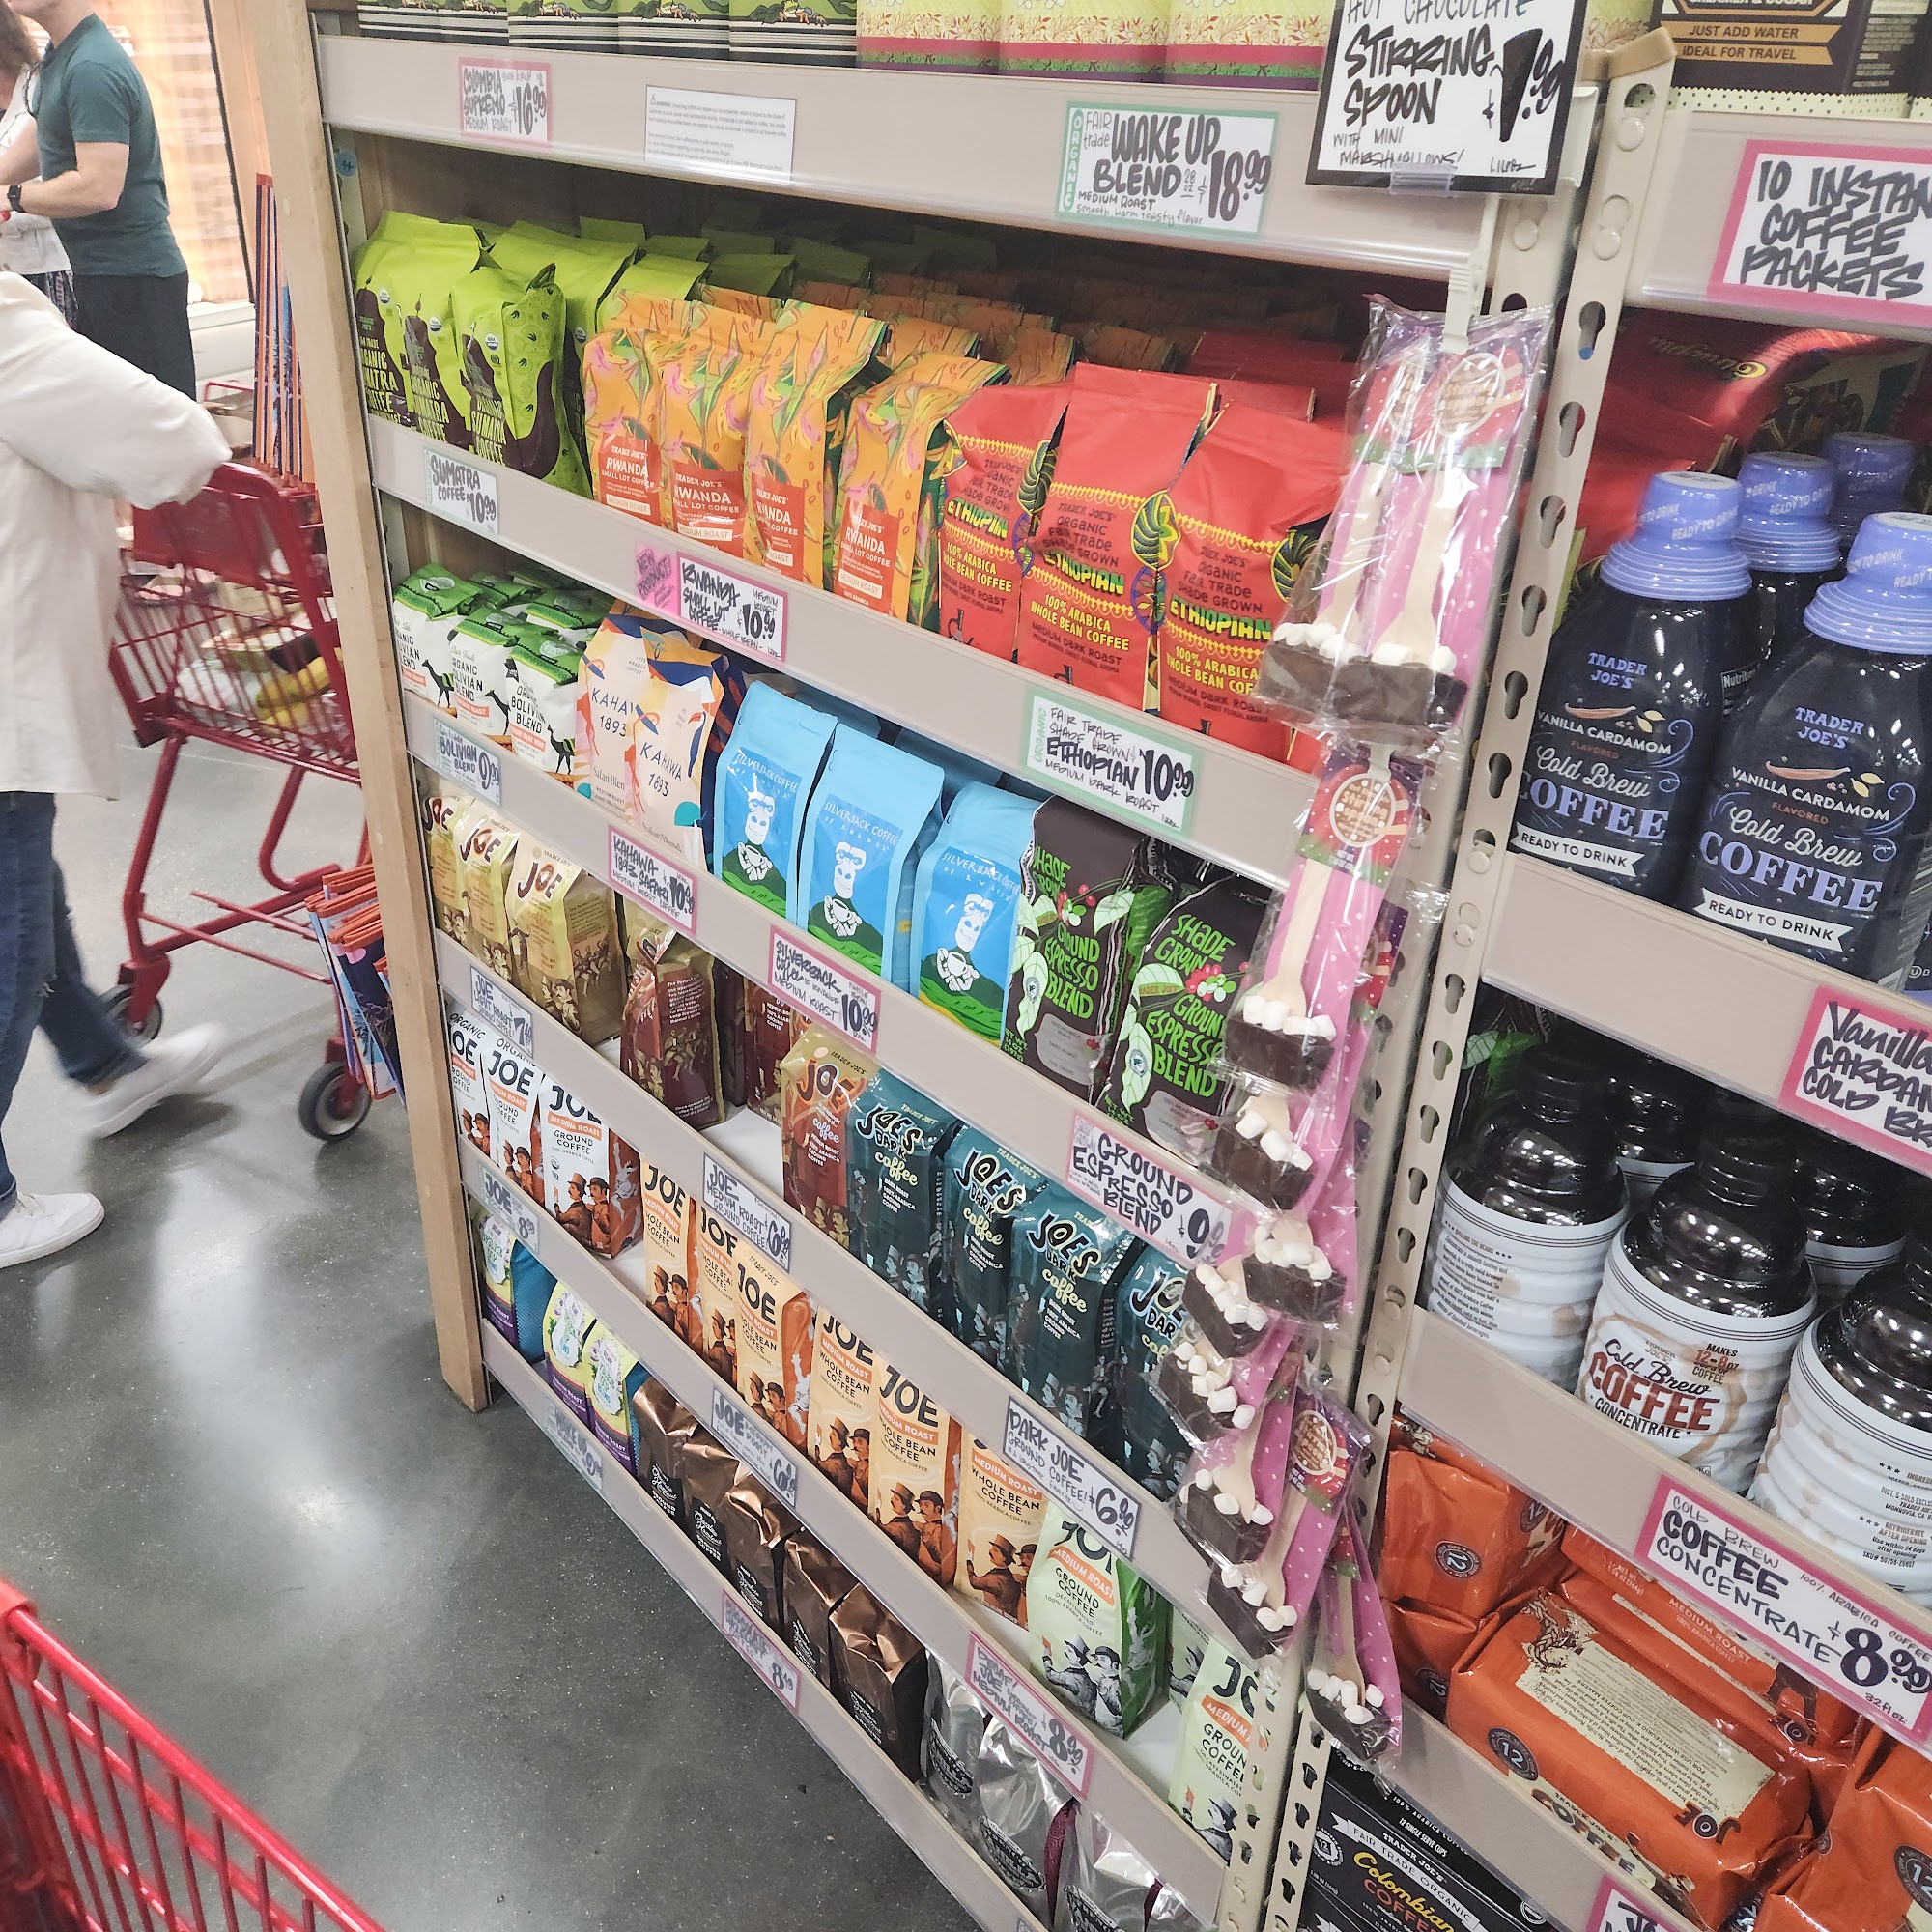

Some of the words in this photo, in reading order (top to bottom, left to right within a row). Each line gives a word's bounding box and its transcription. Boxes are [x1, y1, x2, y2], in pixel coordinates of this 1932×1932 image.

[1690, 26, 1719, 37] JUST
[1723, 26, 1750, 38] ADD
[1754, 27, 1799, 39] WATER
[1344, 23, 1495, 78] STIRRING
[1682, 45, 1717, 57] IDEAL
[1720, 47, 1745, 58] FOR
[1748, 48, 1797, 60] TRAVEL
[464, 66, 503, 96] COLOMBIA
[464, 93, 506, 116] SUPREMO
[1344, 78, 1442, 127] SPOON
[1086, 112, 1111, 130] FAIR
[1084, 132, 1110, 149] trade
[1111, 113, 1182, 163] WAKE
[1185, 114, 1221, 165] UP
[1333, 128, 1361, 148] WITH
[1374, 126, 1404, 145] MINI
[1093, 159, 1182, 198] BLEND
[1757, 160, 1793, 202] 10
[1078, 191, 1118, 204] MEDIUM
[1121, 196, 1156, 211] ROAST
[1759, 203, 1915, 257] COFFEE
[1740, 245, 1925, 300] PACKETS
[431, 454, 481, 490] SUMATRA
[602, 469, 618, 480] SMALL
[619, 473, 630, 482] LOT
[606, 457, 649, 477] RWANDA
[438, 485, 466, 502] COFFEE
[692, 502, 706, 511] LOT
[708, 504, 740, 513] COFFEE
[704, 529, 728, 539] ROAST
[845, 527, 886, 554] RWANDA
[1073, 533, 1112, 552] TRADE
[855, 549, 865, 558] LOT
[866, 554, 891, 567] COFFEE
[963, 552, 996, 576] ARABICA
[957, 561, 976, 583] BEAN
[977, 571, 1012, 593] COFFEE
[1044, 551, 1126, 597] ETHIOPIAN
[1894, 571, 1927, 588] READY
[683, 587, 710, 612] SMALL
[714, 601, 729, 620] LOT
[1045, 593, 1067, 615] 100%
[1068, 608, 1111, 633] ARABICA
[1170, 593, 1272, 643] ETHIOPIAN
[1031, 600, 1058, 625] WHOLE
[1059, 616, 1083, 638] BEAN
[1087, 626, 1130, 651] COFFEE
[1088, 646, 1122, 666] ROAST
[1176, 644, 1201, 668] 100%
[1587, 651, 1648, 676] TRADER
[1195, 668, 1224, 690] BEAN
[1590, 670, 1635, 690] JOE'S
[516, 712, 543, 735] BLEND
[1050, 707, 1077, 725] FAIR
[1795, 706, 1865, 735] TRADER
[1049, 724, 1086, 743] SHADE
[1587, 726, 1672, 756] CARDAMOM
[1797, 726, 1848, 749] JOE'S
[454, 759, 475, 773] BLEND
[1536, 744, 1584, 781] Cold
[1582, 761, 1652, 799] Brew
[648, 772, 668, 797] 1893
[1731, 766, 1788, 796] VANILLA
[1791, 787, 1891, 821] CARDAMOM
[823, 800, 870, 833] SILVERBACK
[871, 822, 898, 846] COFFEE
[1772, 801, 1829, 825] FLAVORED
[1520, 831, 1560, 852] READY
[1561, 842, 1581, 857] TO
[1582, 846, 1629, 867] DRINK
[1729, 806, 1785, 846] Cold
[1784, 826, 1864, 867] Brew
[613, 835, 659, 877] KAHAWA
[1699, 830, 1884, 913] COFFEE
[517, 860, 563, 899] JOE
[1708, 899, 1753, 922] READY
[1757, 914, 1778, 927] TO
[1782, 920, 1833, 941] DRINK
[1171, 913, 1236, 963] SHADE
[1044, 937, 1100, 992] ESPRESSO
[1154, 936, 1208, 977] GROWN
[1044, 975, 1094, 1020] BLEND
[450, 1013, 486, 1040] ORGANIC
[488, 1050, 534, 1096] JOE
[1153, 1042, 1219, 1098] BLEND
[509, 1093, 526, 1109] ROAST
[797, 1058, 867, 1114] JOE
[1803, 1066, 1880, 1111] COLD
[550, 1115, 577, 1130] MEDIUM
[579, 1123, 600, 1138] ROAST
[554, 1130, 594, 1147] GROUND
[812, 1117, 839, 1144] coffee
[556, 1139, 591, 1155] COFFEE
[710, 1164, 740, 1202] JOE
[874, 1151, 918, 1186] coffee
[1073, 1145, 1173, 1219] ESPRESSO
[1098, 1132, 1194, 1205] GROUND
[644, 1165, 687, 1219] JOE
[664, 1213, 679, 1231] ROAST
[713, 1200, 741, 1225] GROUND
[738, 1208, 764, 1235] ROAST
[963, 1208, 1004, 1245] coffee
[1103, 1188, 1162, 1236] BLEND
[647, 1223, 670, 1248] COFFEE
[663, 1226, 680, 1245] BEAN
[737, 1263, 776, 1325] JOE
[1042, 1267, 1088, 1313] coffee
[753, 1319, 775, 1337] ROAST
[754, 1332, 778, 1351] BEAN
[822, 1339, 845, 1365] MEDIUM
[845, 1359, 868, 1379] ROAST
[1706, 1343, 1739, 1357] MAKES
[1605, 1338, 1645, 1374] Cold
[1644, 1360, 1712, 1395] Brew
[1691, 1366, 1725, 1385] COFFEE
[826, 1368, 857, 1399] COFFEE
[844, 1374, 870, 1395] BEAN
[1590, 1351, 1720, 1431] COFFEE
[904, 1424, 935, 1441] ROAST
[1595, 1397, 1681, 1439] CONCENTRATE
[883, 1433, 920, 1463] COFFEE
[905, 1438, 937, 1457] BEAN
[1008, 1432, 1046, 1468] GROUND
[1009, 1409, 1048, 1452] DARK
[1050, 1444, 1085, 1483] JOE
[971, 1465, 1007, 1494] WHOLE
[1008, 1492, 1040, 1511] BEAN
[973, 1455, 1007, 1480] MEDIUM
[1008, 1477, 1037, 1497] ROAST
[980, 1486, 1023, 1516] COFFEE
[1672, 1495, 1708, 1524] COLD
[1723, 1526, 1779, 1569] BREW
[1879, 1528, 1900, 1540] AFTER
[1901, 1535, 1927, 1545] OPENING
[1885, 1522, 1925, 1537] REFRIGERATE
[1886, 1541, 1904, 1549] within
[1448, 1553, 1466, 1573] 12
[1663, 1509, 1789, 1600] COFFEE
[1055, 1566, 1100, 1610] GROUND
[1057, 1579, 1096, 1619] COFFEE
[1656, 1535, 1841, 1664] CONCENTRATE
[1828, 1590, 1880, 1628] ARABICA
[1668, 1597, 1714, 1635] MEDIUM
[1715, 1633, 1751, 1662] ROAST
[1863, 1691, 1883, 1709] 32
[1207, 1701, 1247, 1737] MEDIUM
[1501, 1740, 1525, 1770] 12
[1393, 1796, 1410, 1812] 100%
[1399, 1817, 1406, 1827] 12
[1435, 1844, 1448, 1858] CUPS
[1674, 1801, 1742, 1845] JOE
[1353, 1827, 1377, 1847] FAIR
[1380, 1845, 1415, 1878] TRADE
[1382, 1832, 1418, 1862] TRADER
[1354, 1852, 1455, 1932] Colombian
